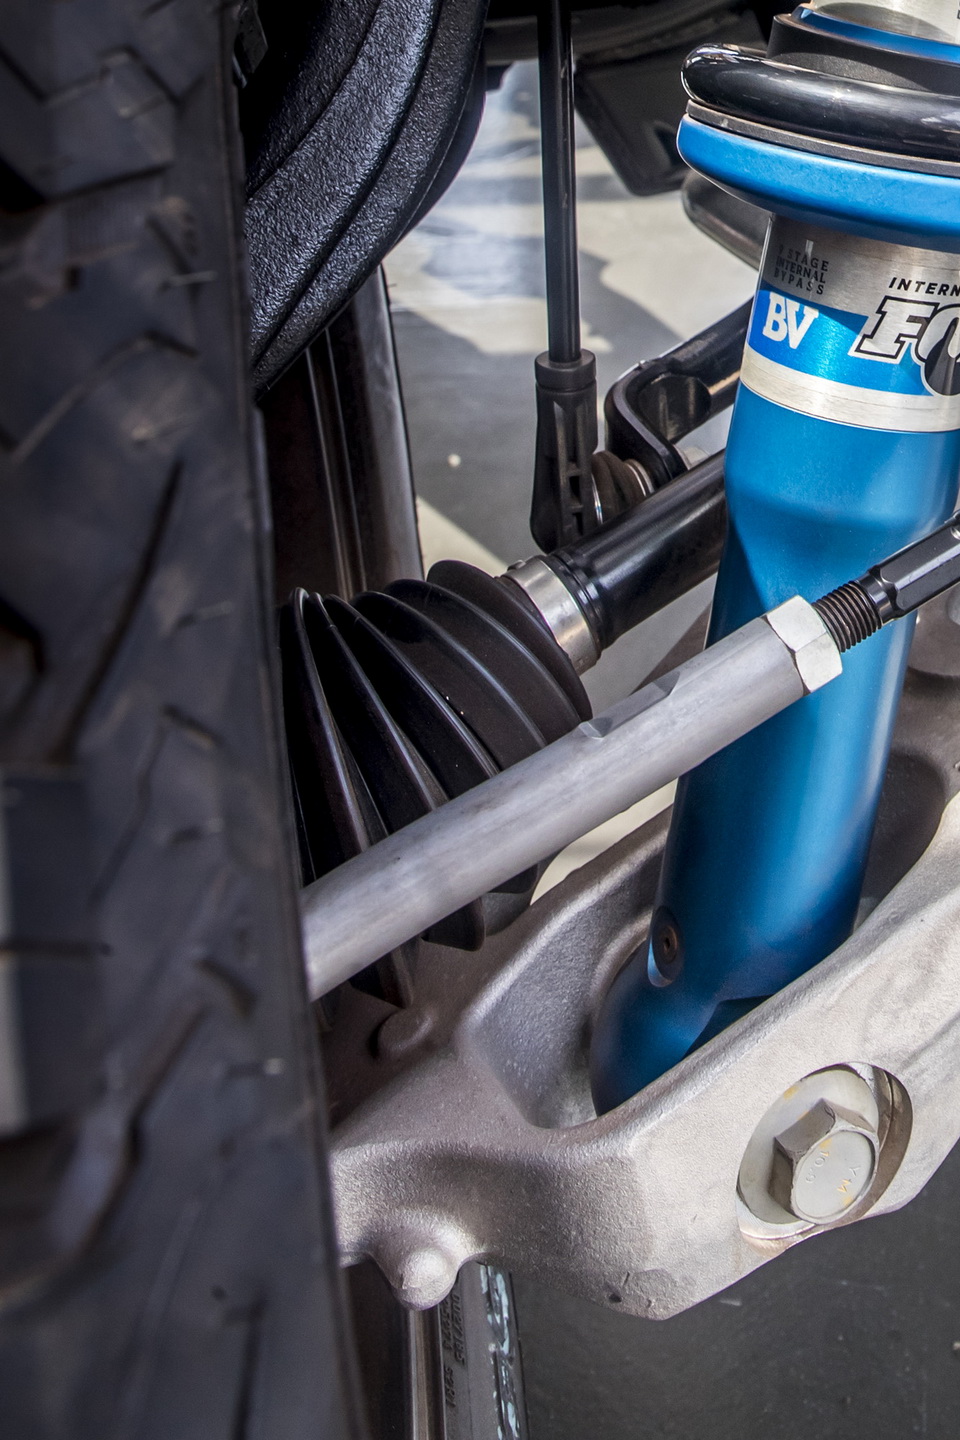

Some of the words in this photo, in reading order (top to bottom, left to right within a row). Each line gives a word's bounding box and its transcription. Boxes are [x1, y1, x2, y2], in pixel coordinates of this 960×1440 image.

[775, 255, 826, 284] INTERNAL
[787, 248, 829, 272] STAGE
[773, 266, 825, 296] BYPASS
[762, 291, 820, 350] BV
